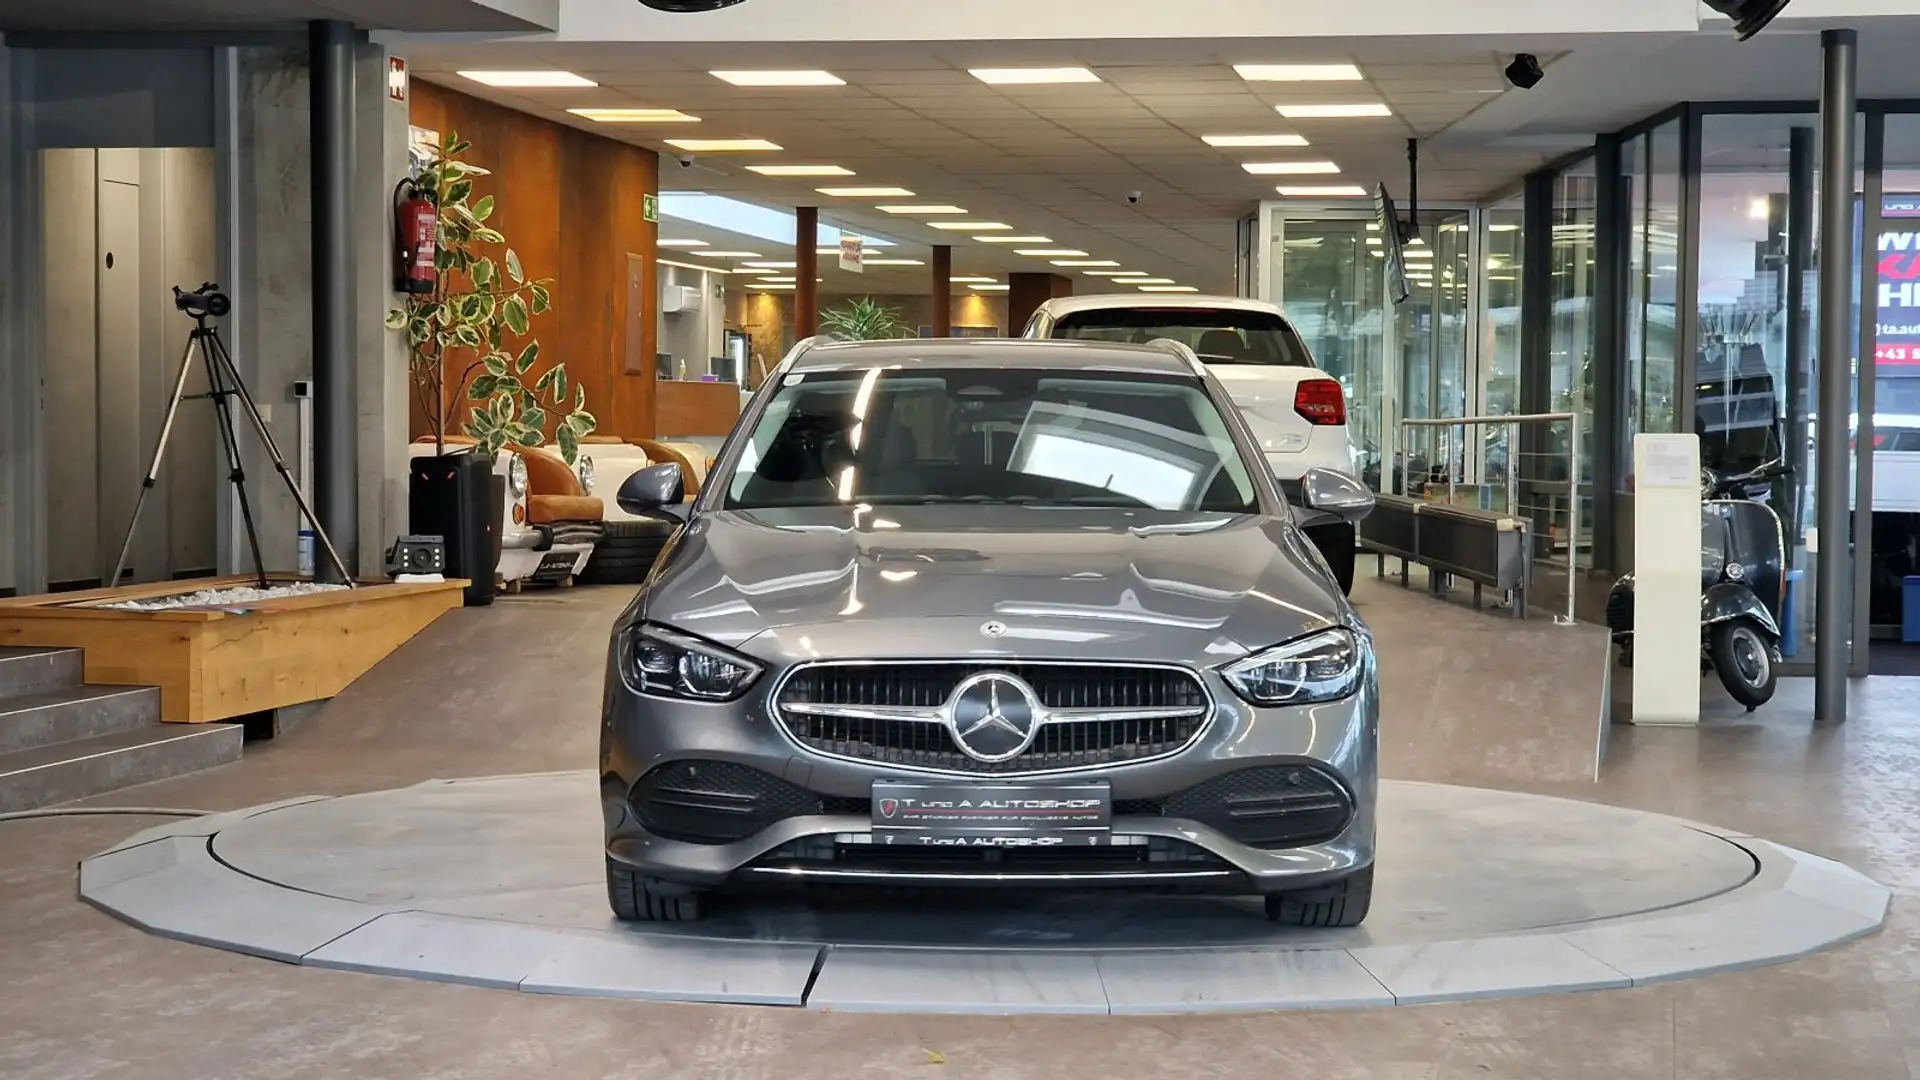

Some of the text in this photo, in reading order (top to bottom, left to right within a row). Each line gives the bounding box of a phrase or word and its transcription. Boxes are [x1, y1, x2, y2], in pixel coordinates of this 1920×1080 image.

[901, 798, 917, 807] T
[958, 799, 973, 808] A
[978, 799, 1101, 808] AUTOSHOP
[973, 837, 1063, 846] AUTOSHOP
